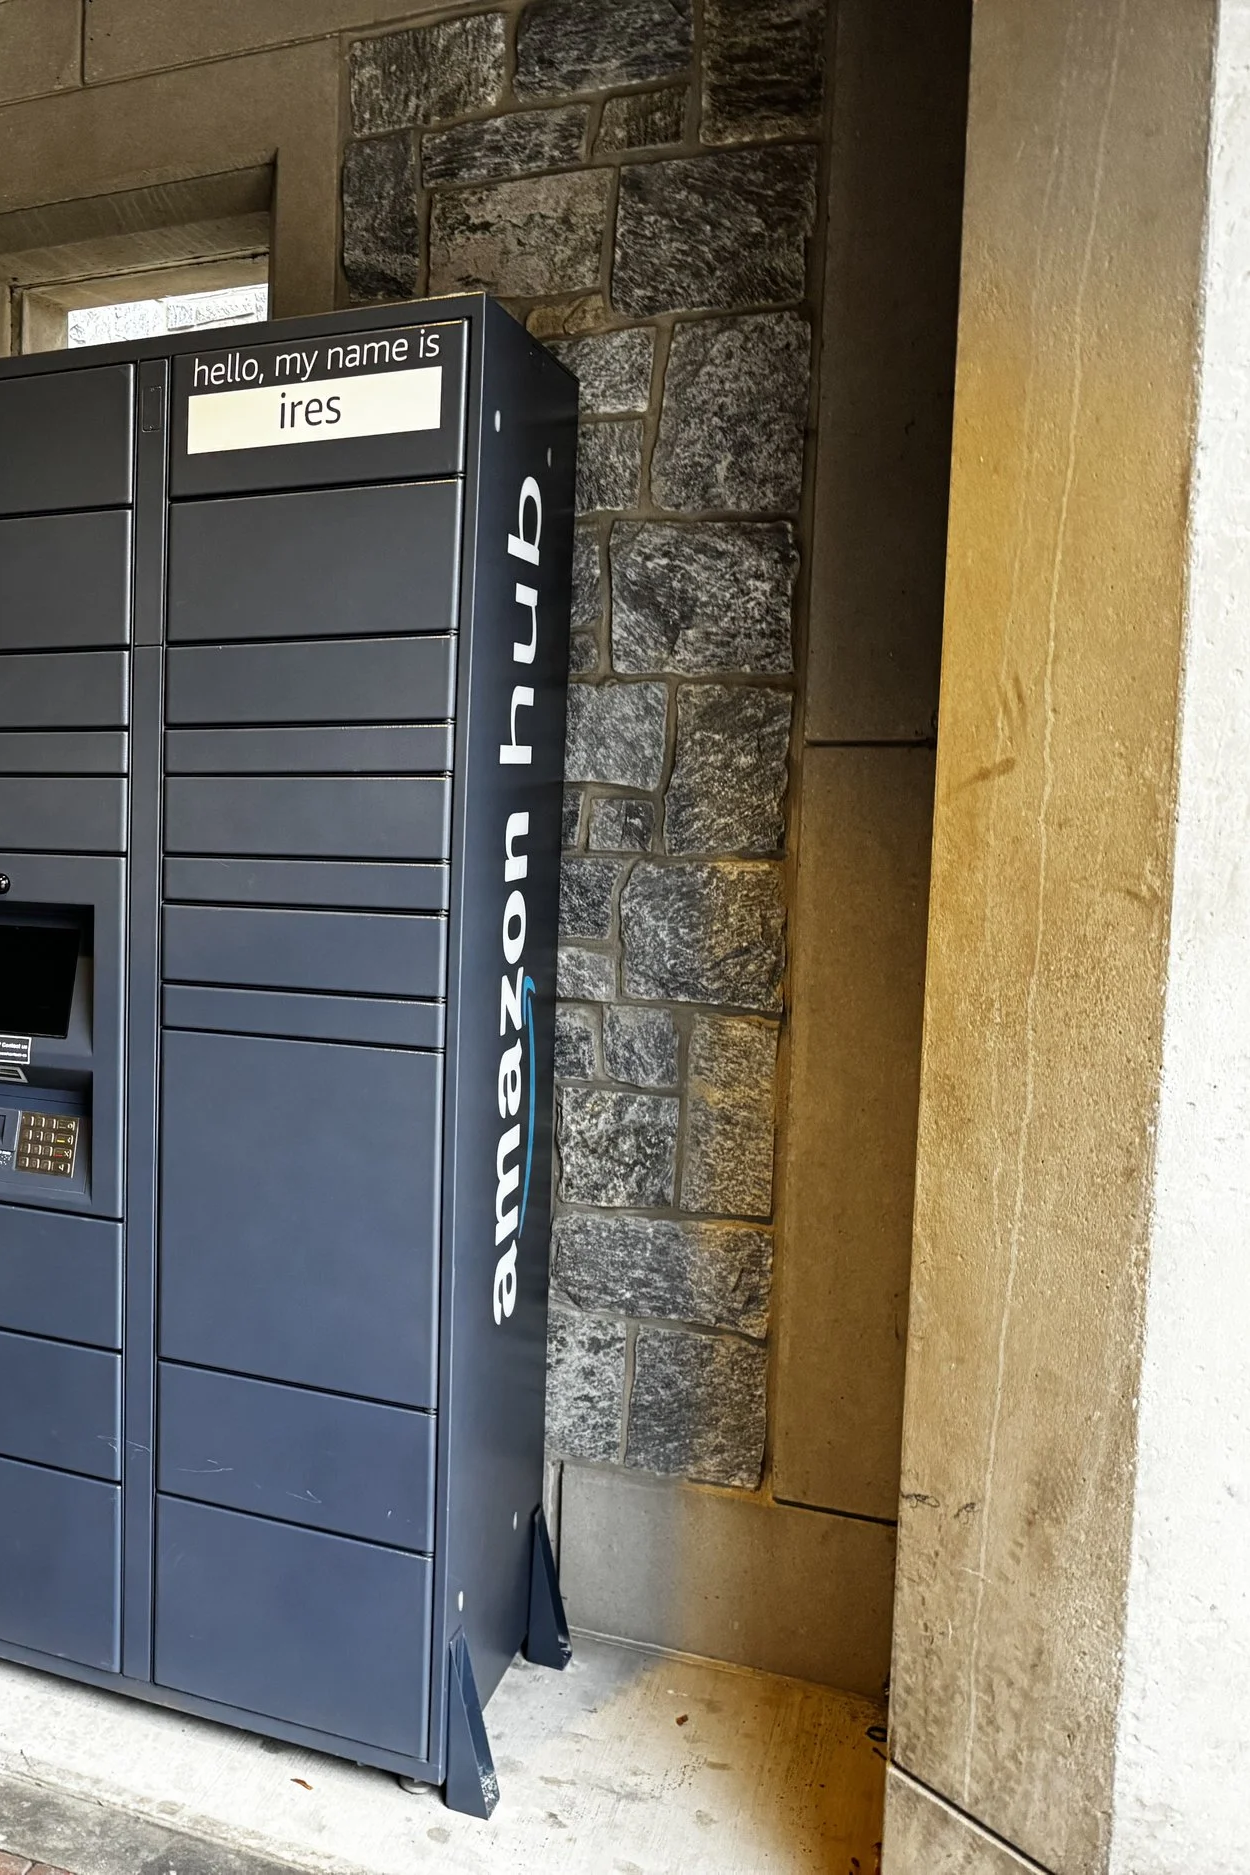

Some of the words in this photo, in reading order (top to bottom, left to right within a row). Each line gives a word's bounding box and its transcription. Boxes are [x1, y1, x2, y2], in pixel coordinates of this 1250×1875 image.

[193, 352, 265, 386] hello,
[274, 350, 320, 382] my
[326, 338, 409, 370] name
[418, 328, 441, 359] is
[279, 392, 342, 430] ires
[499, 475, 543, 765] hub
[492, 810, 531, 1327] amazon
